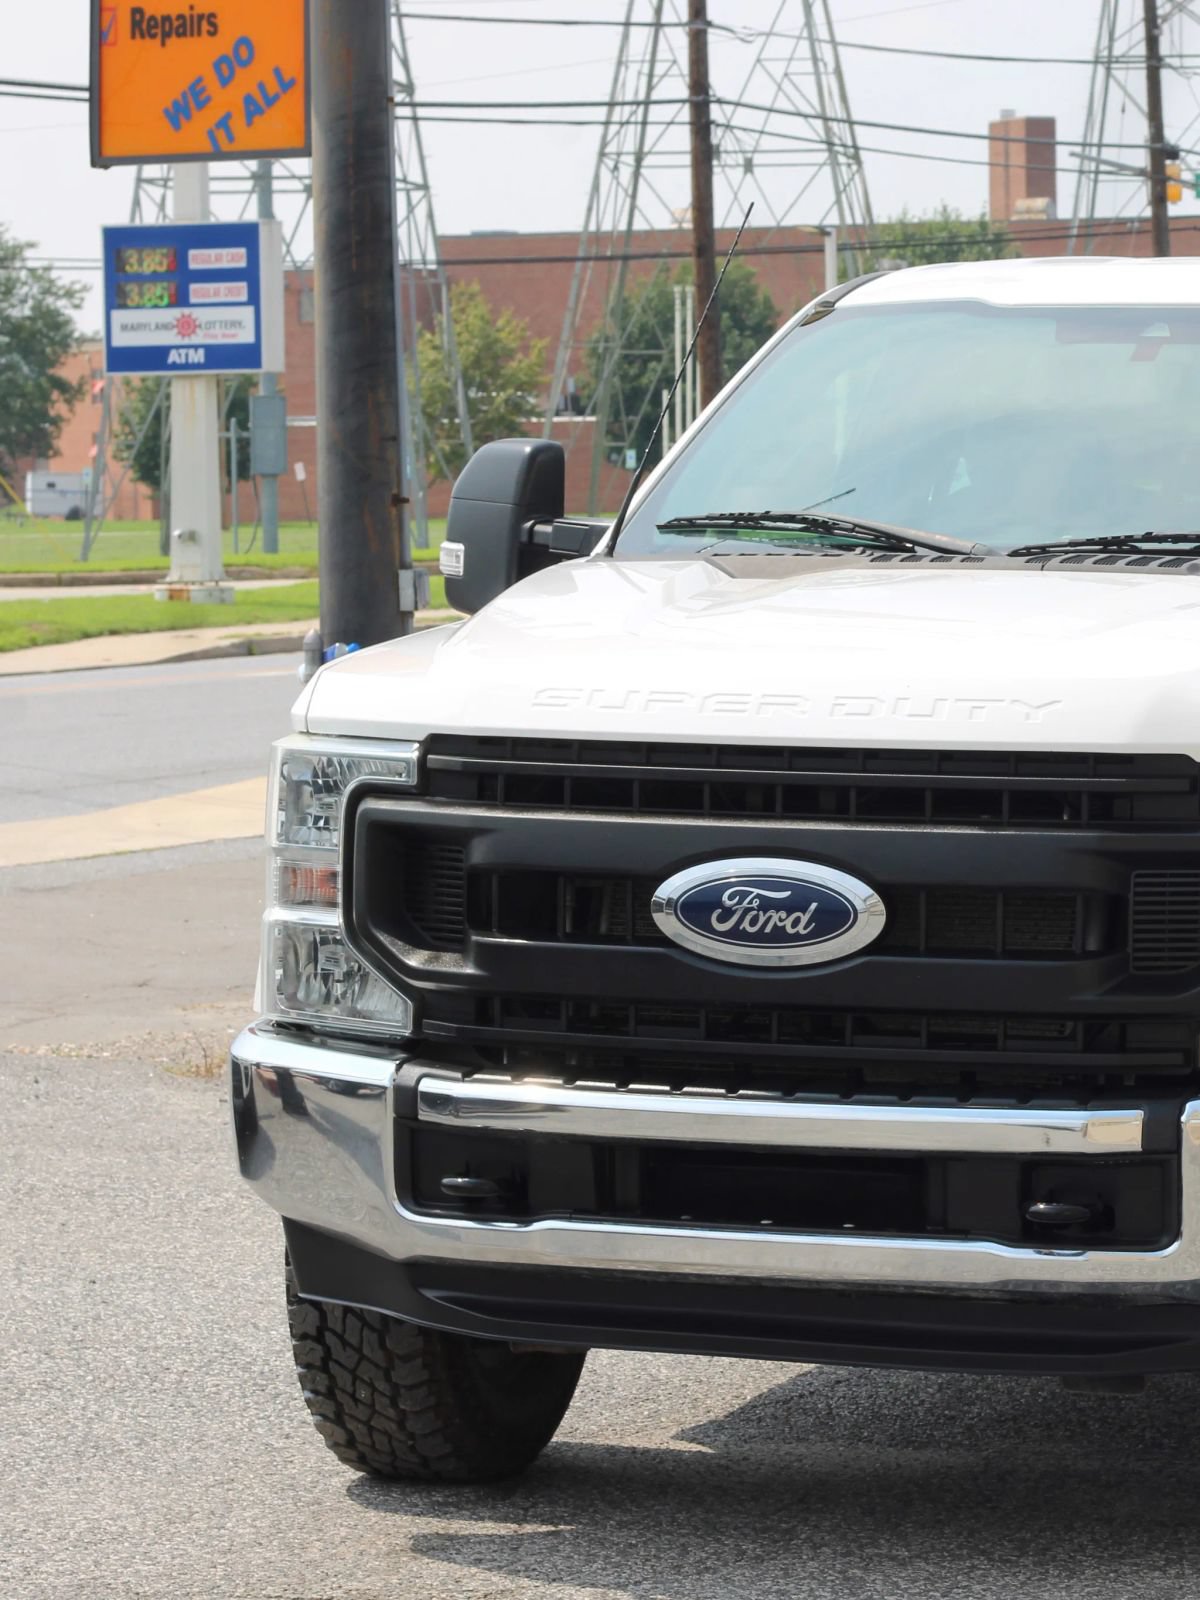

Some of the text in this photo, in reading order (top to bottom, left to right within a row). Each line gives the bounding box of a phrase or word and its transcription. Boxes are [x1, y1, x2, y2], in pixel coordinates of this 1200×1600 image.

[130, 5, 219, 47] Repairs
[162, 35, 255, 132] WE DO
[207, 66, 297, 152] IT ALL
[119, 321, 176, 333] MARYLAND
[167, 347, 206, 365] ATM
[530, 686, 1063, 724] SUPER DUTY
[710, 885, 818, 935] Ford
